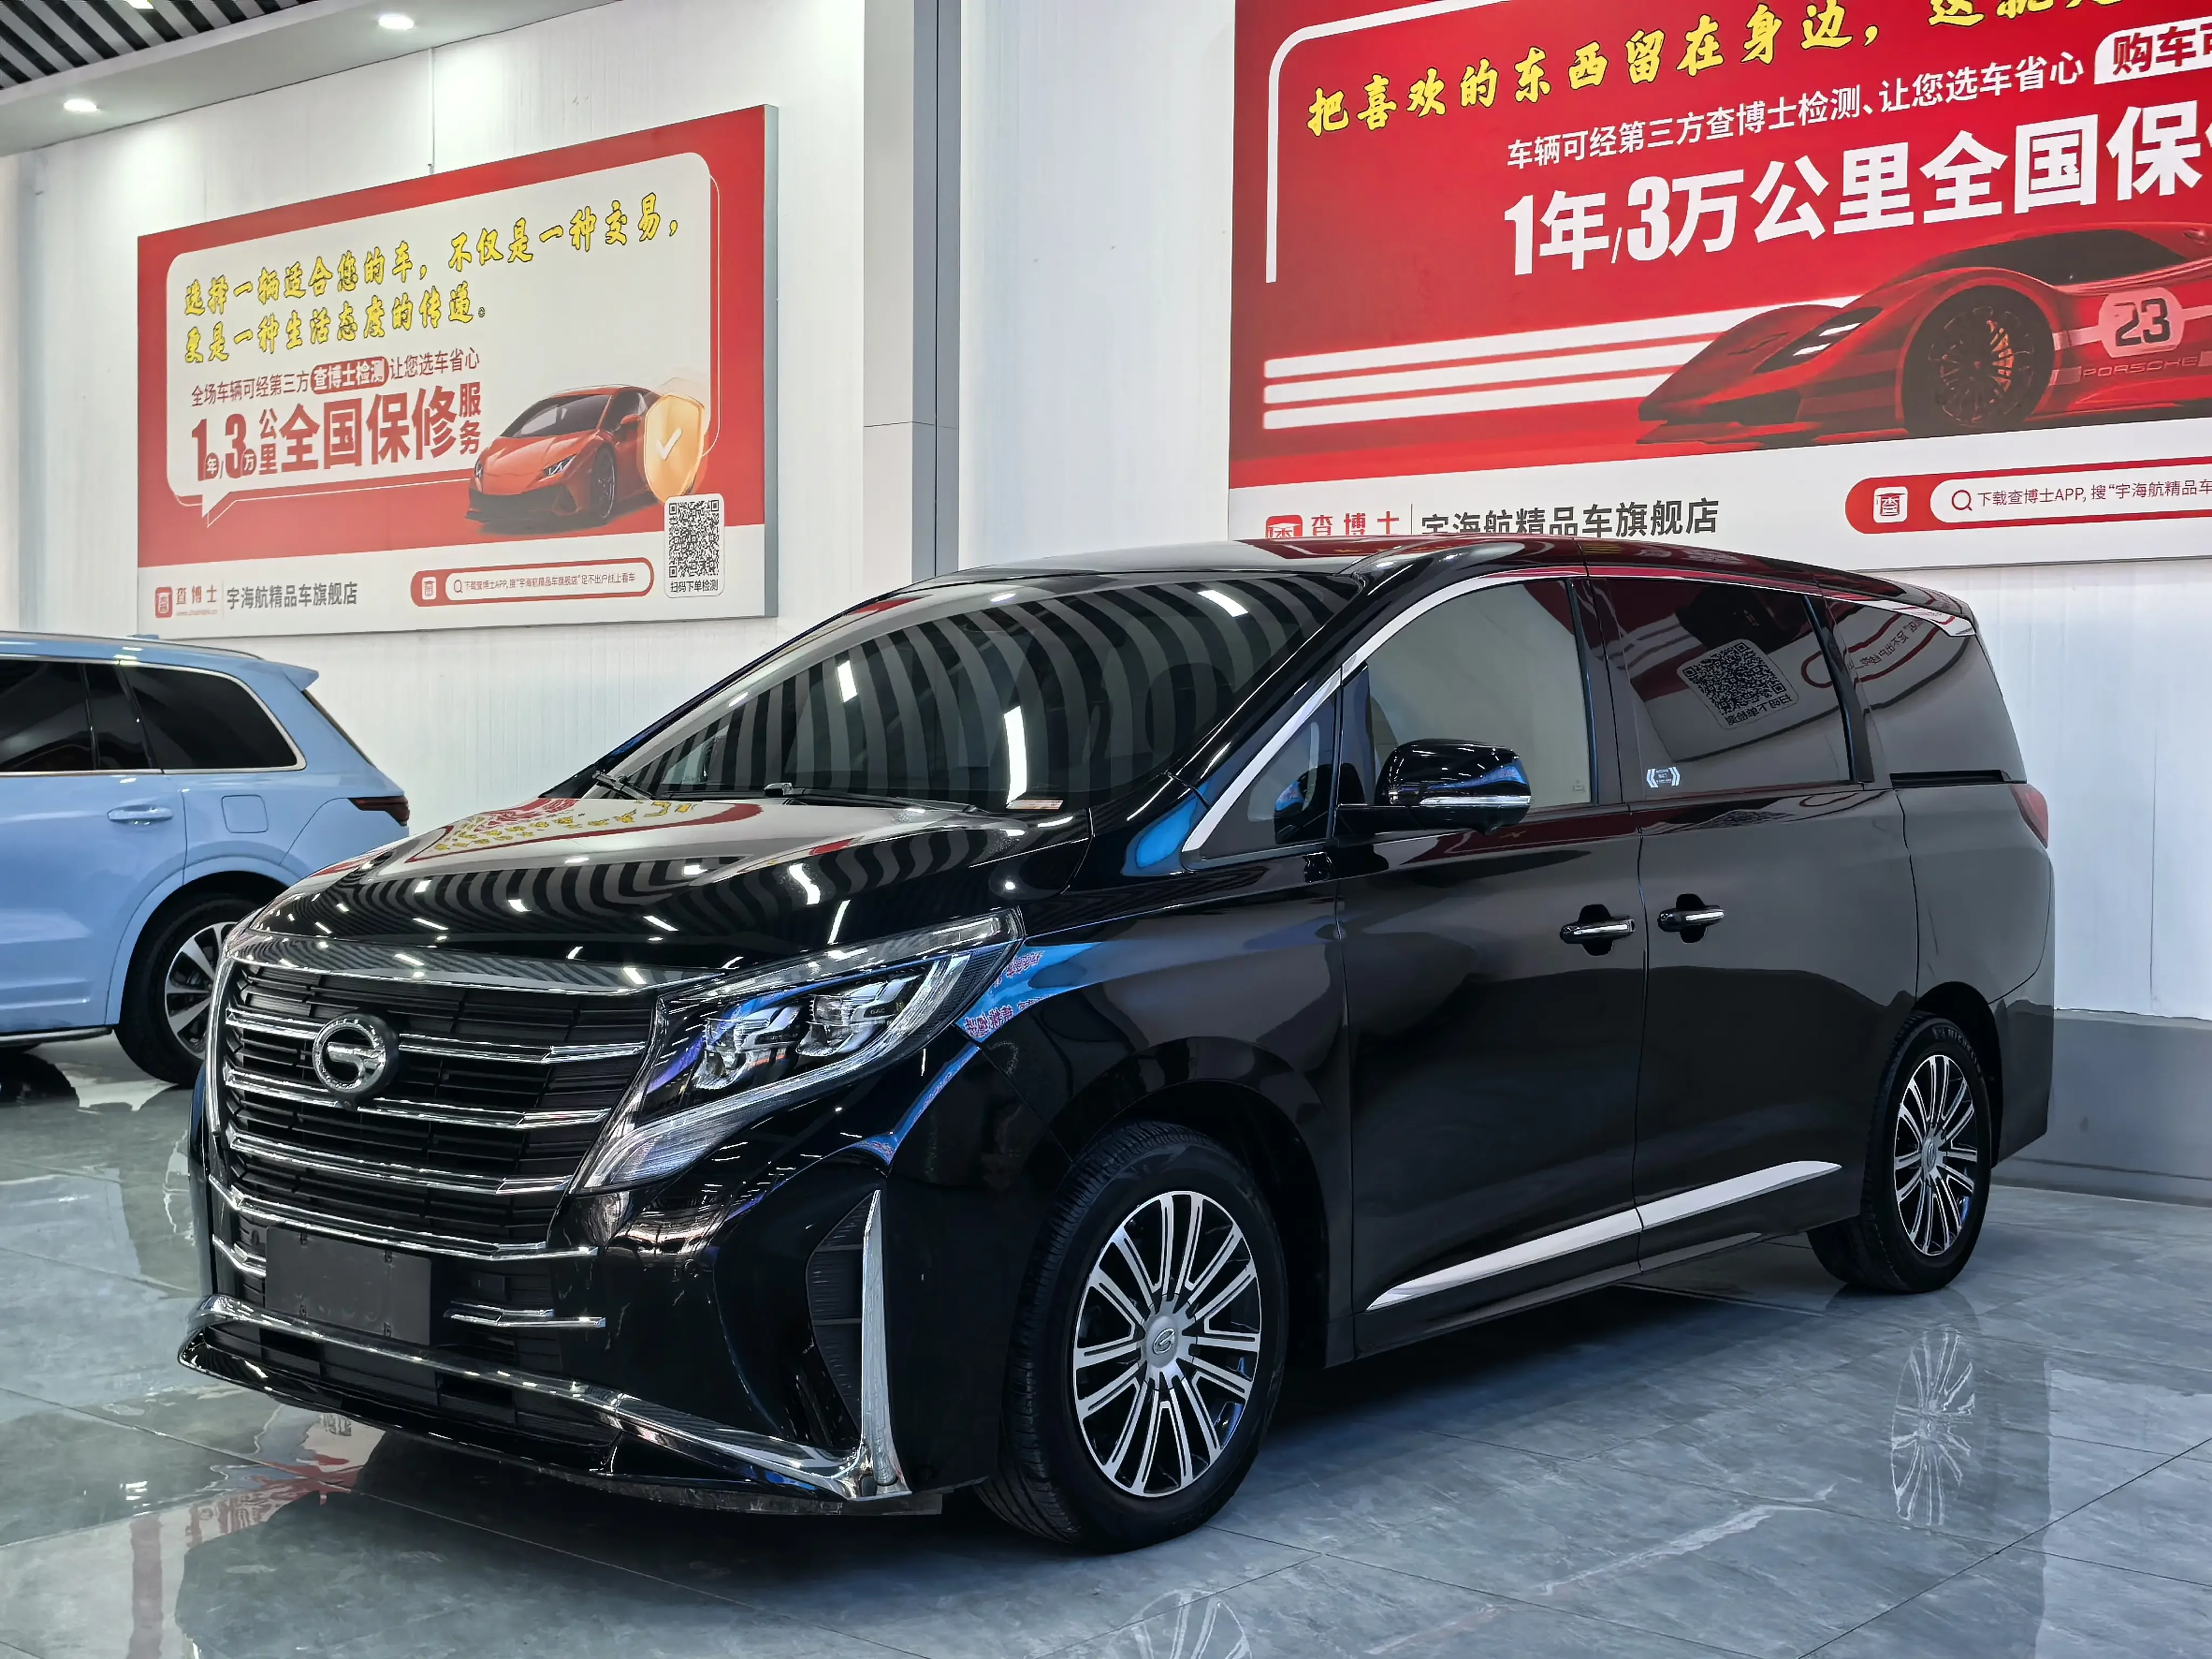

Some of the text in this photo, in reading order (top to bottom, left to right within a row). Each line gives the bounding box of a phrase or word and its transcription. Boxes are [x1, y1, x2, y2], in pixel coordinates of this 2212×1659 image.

[2113, 21, 2212, 75] 购车
[1505, 100, 2212, 276] 1年/3万公里全国保
[2114, 298, 2170, 347] 23
[2083, 357, 2199, 376] PORSCHE
[671, 579, 718, 593] 扫码下单检测
